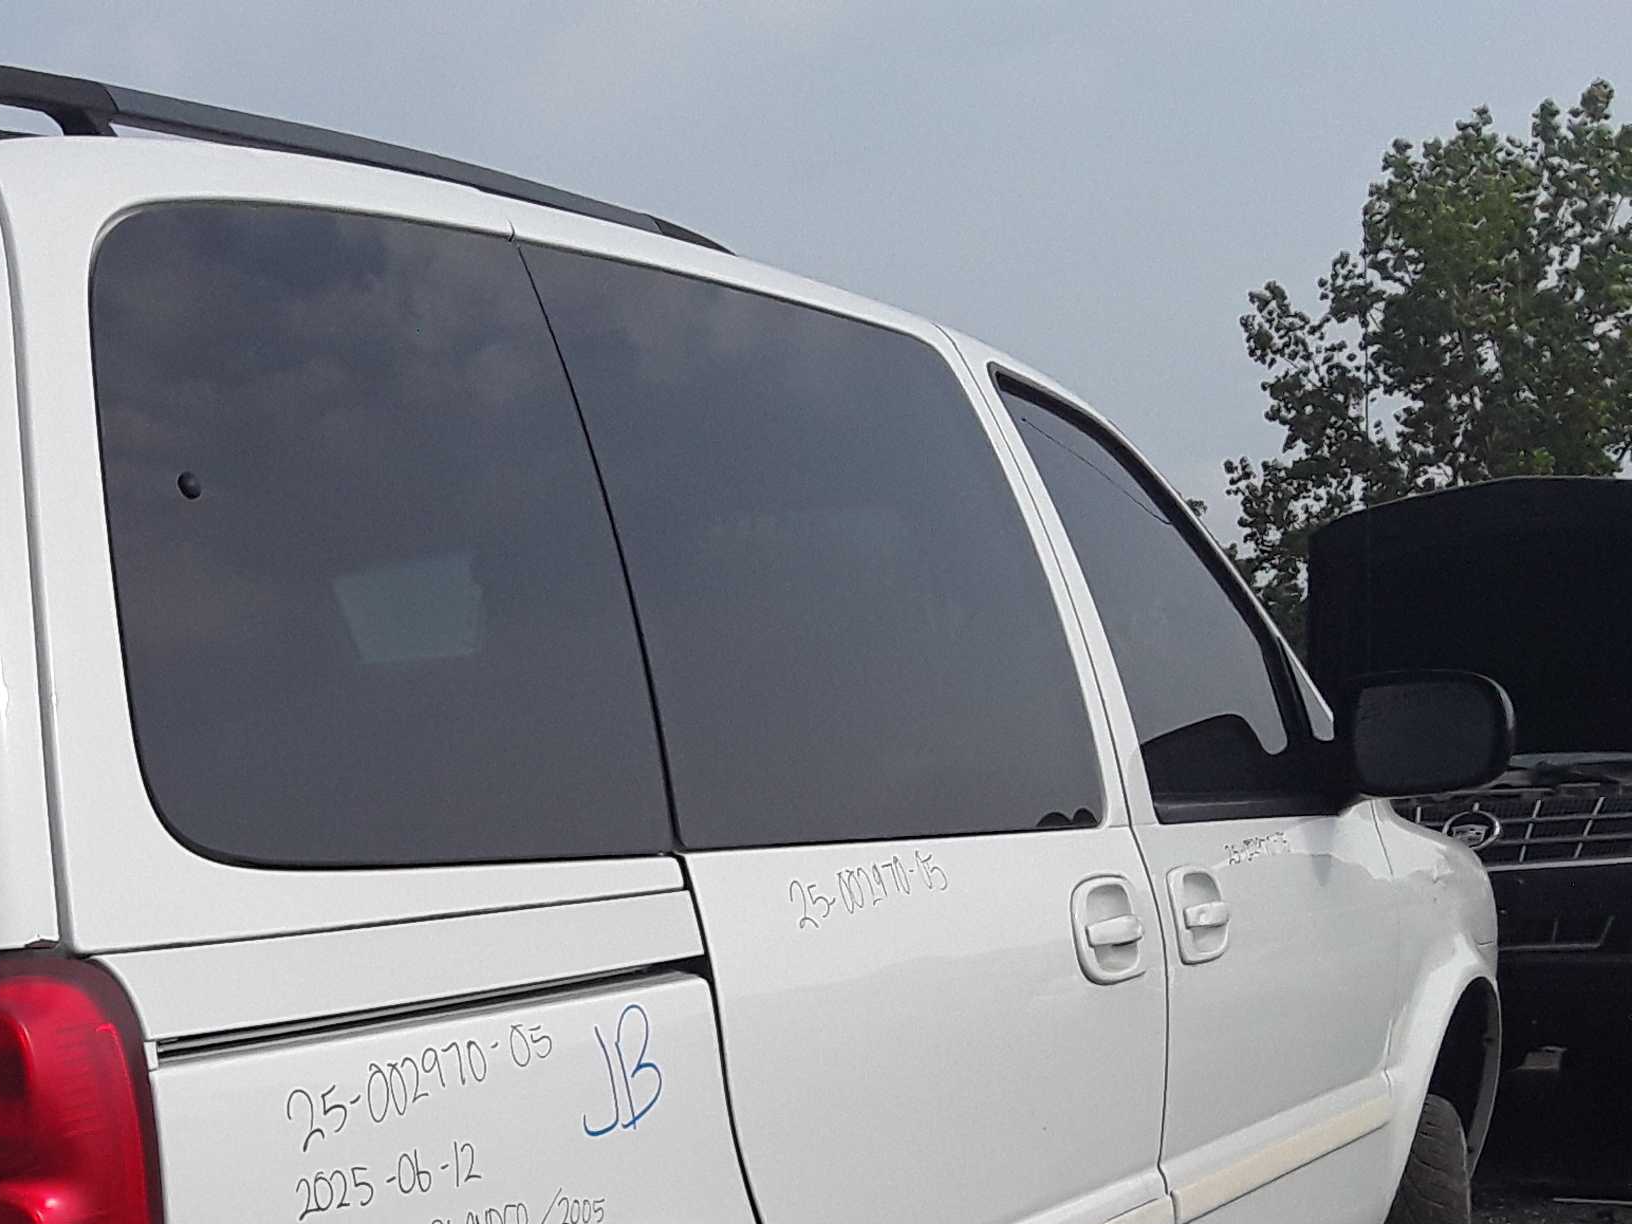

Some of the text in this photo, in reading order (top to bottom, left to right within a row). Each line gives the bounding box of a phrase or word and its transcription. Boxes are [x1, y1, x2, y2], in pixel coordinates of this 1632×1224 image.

[287, 1023, 552, 1152] 25-002970-05
[583, 1003, 663, 1136] JB
[295, 1141, 482, 1221] 2025-06-12
